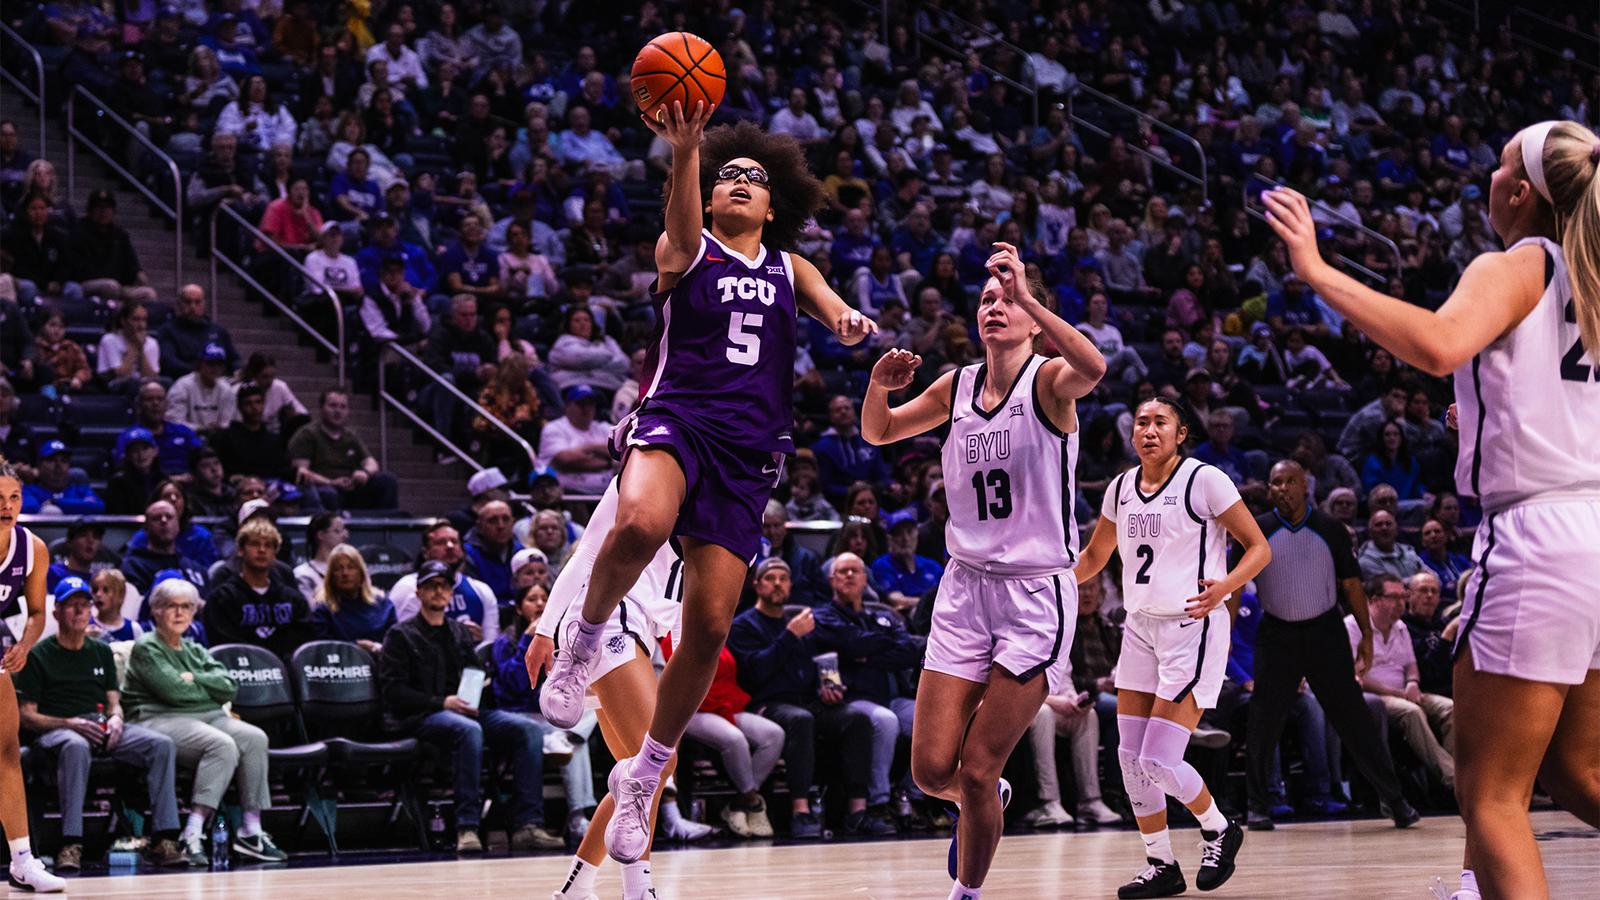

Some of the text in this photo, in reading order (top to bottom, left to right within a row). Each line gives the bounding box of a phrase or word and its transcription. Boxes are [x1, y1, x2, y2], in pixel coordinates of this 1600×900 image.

[717, 276, 776, 306] TCU
[726, 311, 764, 367] 5
[1560, 297, 1600, 382] 2
[966, 429, 1011, 464] BYU
[972, 468, 1012, 521] 13
[1128, 513, 1161, 538] BYU
[1135, 544, 1154, 585] 2
[229, 668, 284, 681] PPHIRE
[303, 665, 373, 679] SAPPHIRE
